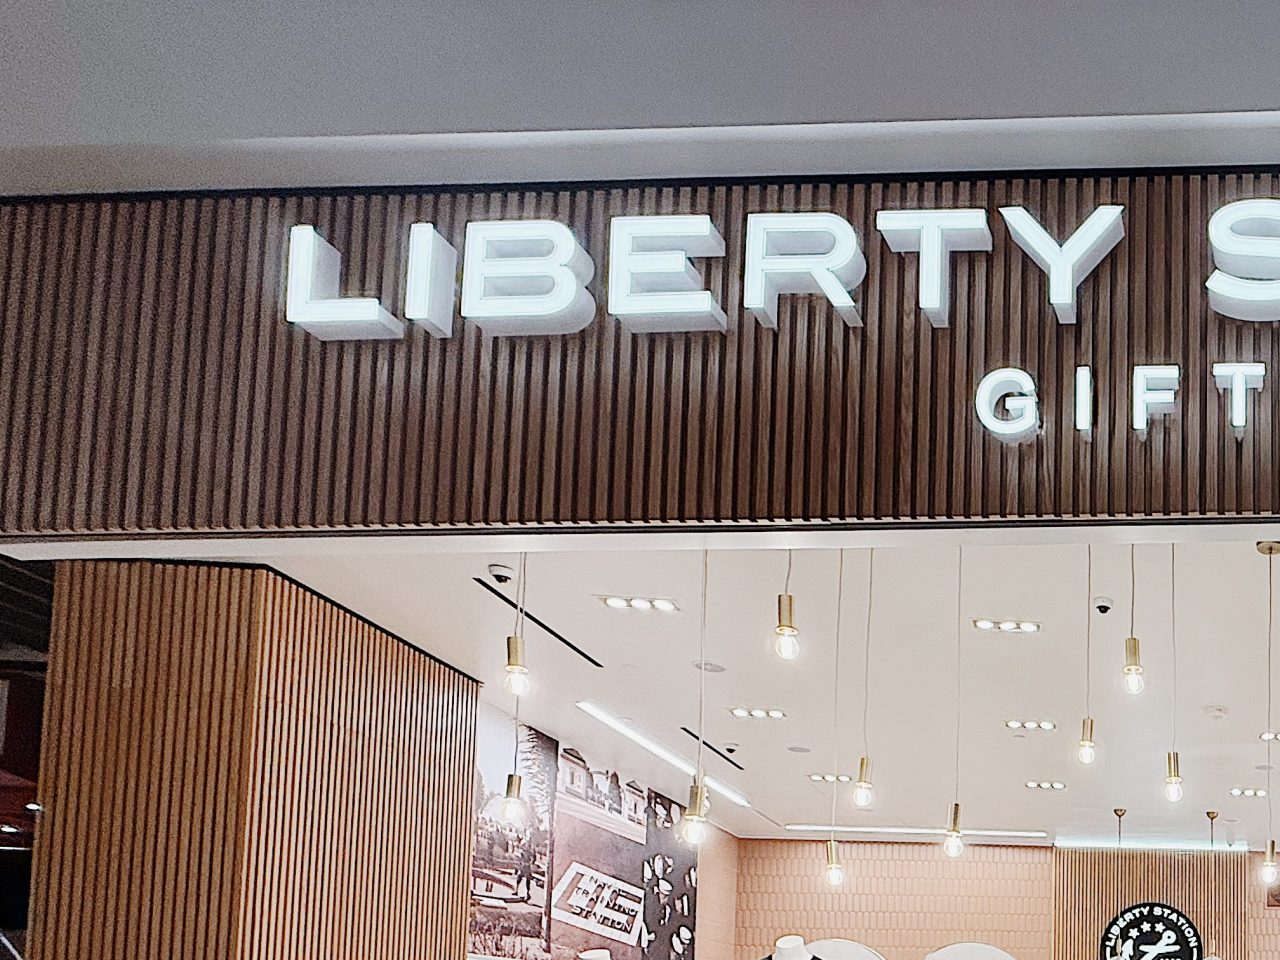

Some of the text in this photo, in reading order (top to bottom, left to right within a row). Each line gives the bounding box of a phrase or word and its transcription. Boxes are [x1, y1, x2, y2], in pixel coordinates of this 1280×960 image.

[285, 202, 1126, 338] LIBERTY
[575, 886, 639, 915] TRAINING
[571, 904, 632, 934] STATION
[1105, 906, 1198, 947] LIBERTY STATION
